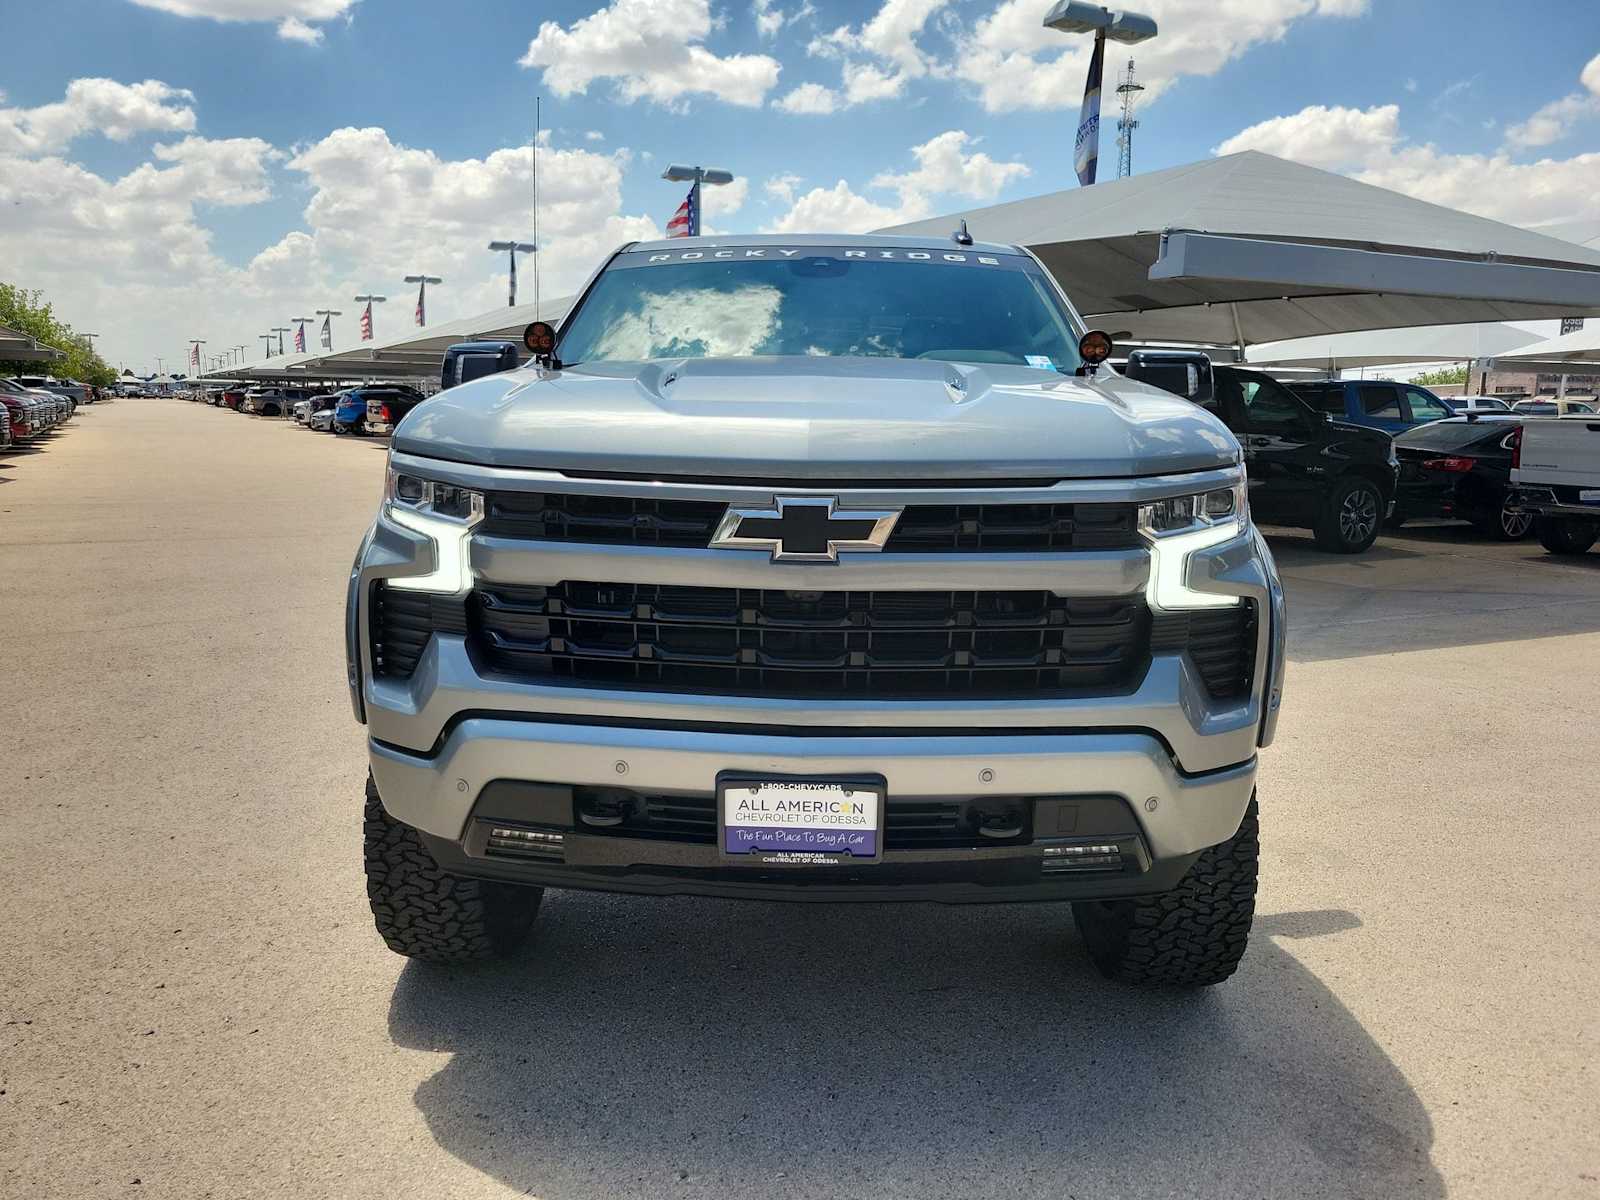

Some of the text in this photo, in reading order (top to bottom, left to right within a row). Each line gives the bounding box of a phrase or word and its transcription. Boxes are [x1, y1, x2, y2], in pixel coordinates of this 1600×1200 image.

[649, 250, 1000, 266] ROCKY RIDGE
[738, 799, 864, 814] ALL AMERICN
[735, 812, 867, 825] CHEVROLET OF ODESSA
[736, 830, 865, 846] The Fun Place To Buy A Car
